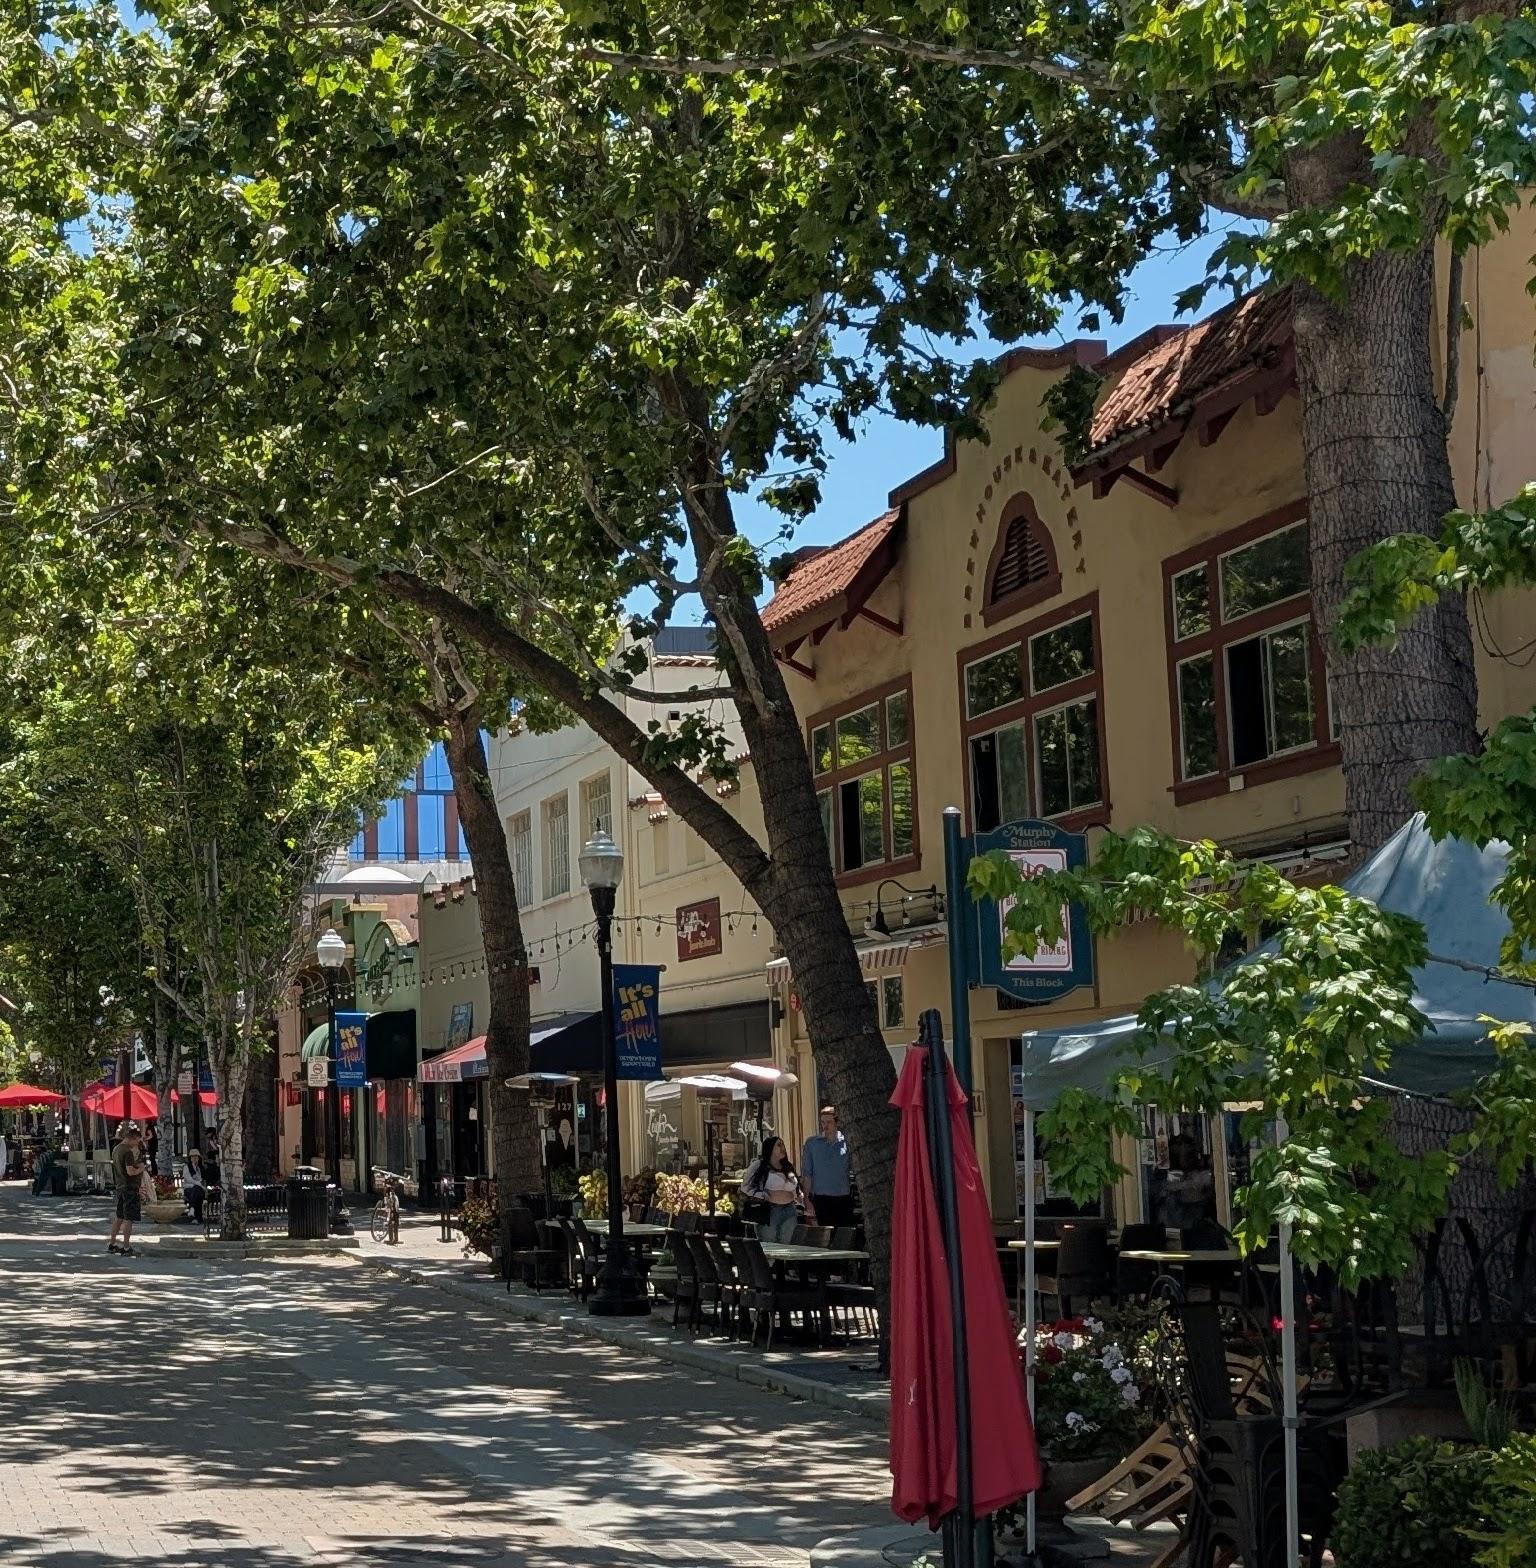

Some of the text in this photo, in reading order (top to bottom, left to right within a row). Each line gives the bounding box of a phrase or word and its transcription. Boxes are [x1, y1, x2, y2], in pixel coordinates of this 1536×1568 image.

[1003, 826, 1057, 838] Murphy
[1010, 837, 1051, 848] Station
[1012, 976, 1064, 987] This Block
[618, 983, 654, 1004] It's
[620, 999, 648, 1022] all
[339, 1026, 362, 1040] It's
[340, 1036, 358, 1051] all
[557, 1102, 572, 1112] 127
